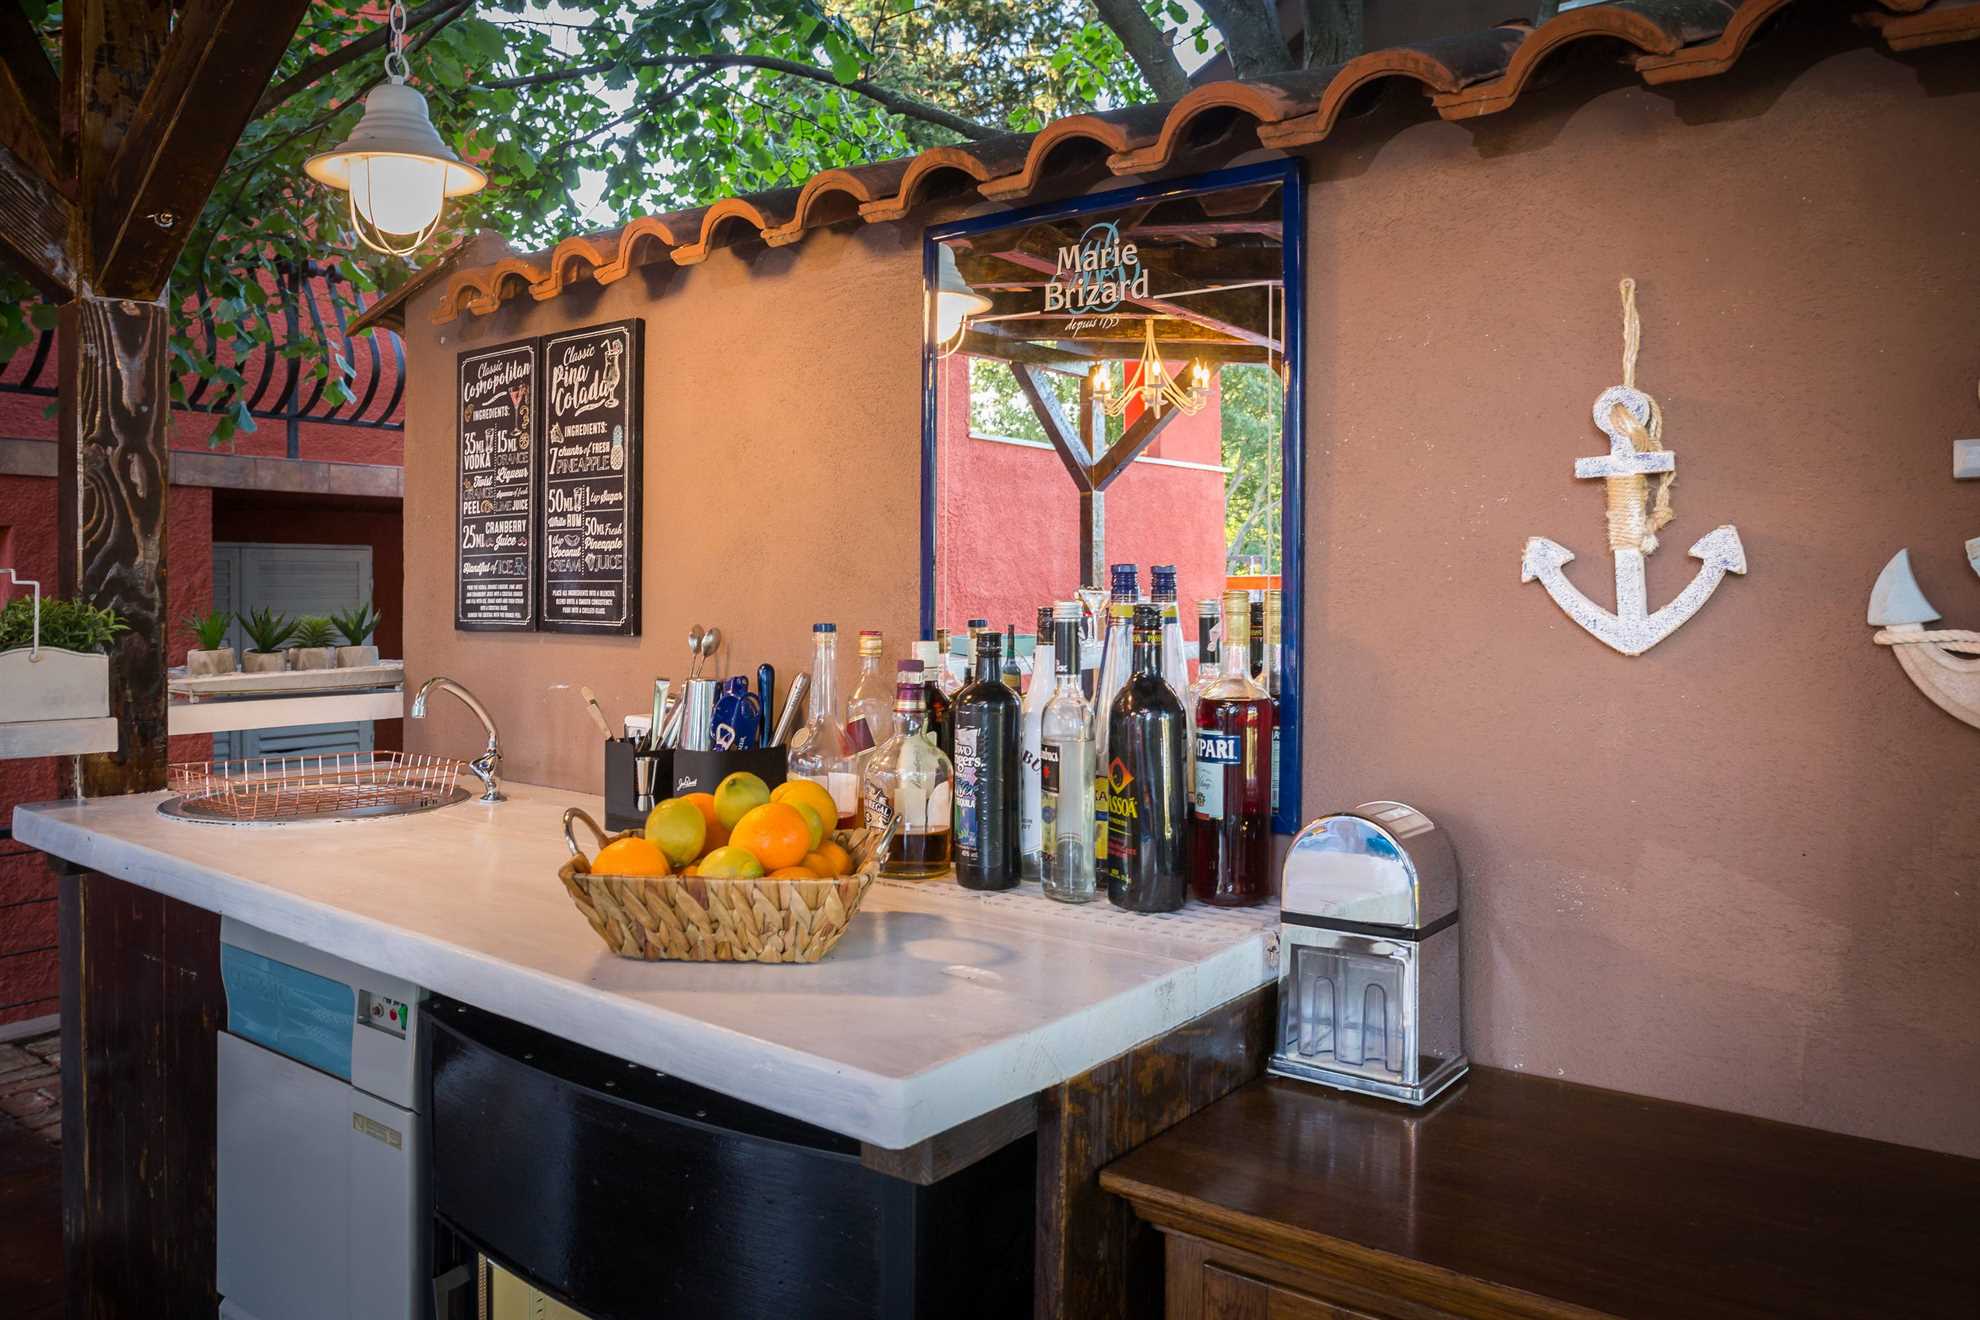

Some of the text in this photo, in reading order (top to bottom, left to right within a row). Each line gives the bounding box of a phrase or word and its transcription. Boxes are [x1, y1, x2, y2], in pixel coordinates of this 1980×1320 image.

[1056, 238, 1138, 276] Marie
[1044, 268, 1149, 312] Brizard
[1065, 317, 1098, 337] depuis
[564, 344, 595, 366] Classic
[478, 360, 504, 379] Classic
[555, 369, 610, 416] Colada
[473, 405, 510, 421] INGREDIENTS:
[565, 421, 608, 437] INGREDIENTS:
[464, 453, 491, 470] VODKA
[556, 455, 610, 474] PINEAPPLE
[496, 466, 528, 483] Liqueur
[512, 499, 528, 511] JUICE
[600, 489, 623, 504] Sugar
[464, 501, 480, 514] PEEL
[485, 520, 527, 534] CRANBERRY
[567, 514, 581, 527] RUM
[605, 522, 623, 536] Fresh
[494, 534, 516, 551] Juice
[585, 536, 623, 551] Pineapple
[552, 545, 581, 558] Coconut
[595, 555, 623, 572] JUICE
